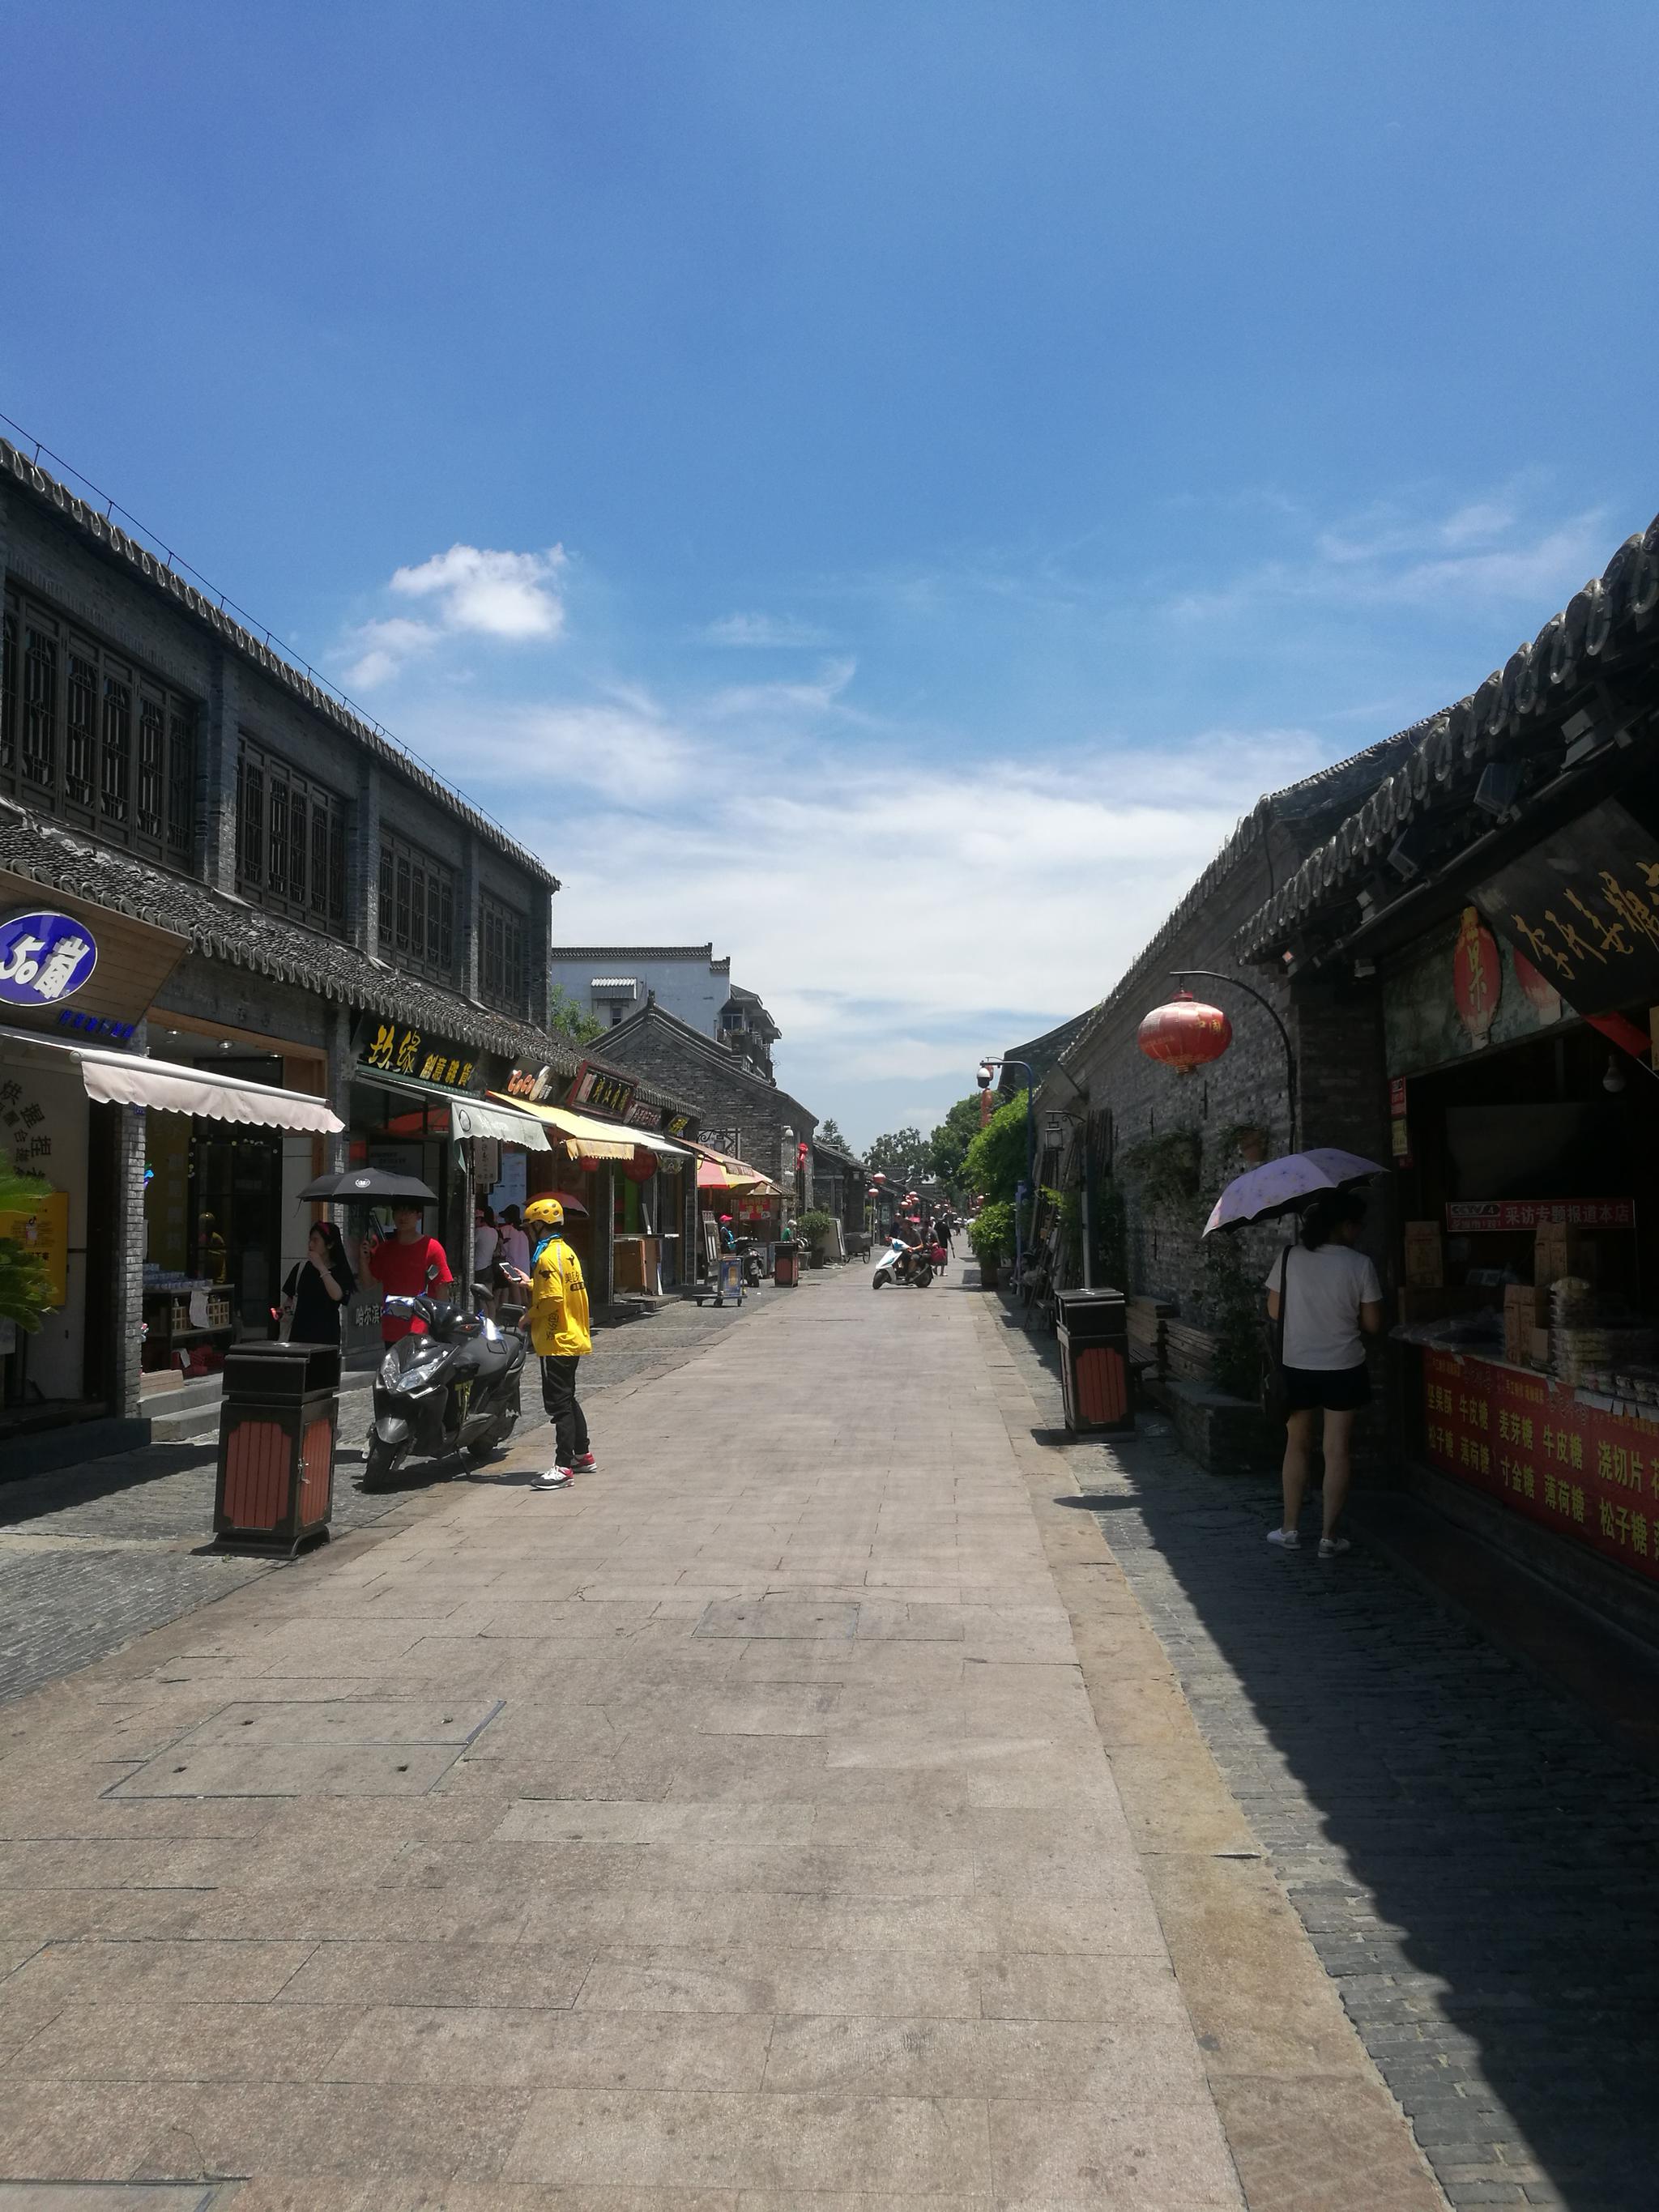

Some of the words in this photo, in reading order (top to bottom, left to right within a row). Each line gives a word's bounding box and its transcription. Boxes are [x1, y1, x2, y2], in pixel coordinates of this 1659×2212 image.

[508, 1069, 535, 1095] CoCo
[1506, 1204, 1630, 1225] 采访专题报道本店
[1459, 1393, 1489, 1431] 牛皮糖
[1460, 1436, 1490, 1475] 薄荷糖
[1499, 1409, 1533, 1451] 麦芽糖
[1543, 1425, 1582, 1470] 牛皮糖
[1501, 1456, 1534, 1498] 寸金糖
[1544, 1473, 1584, 1523] 薄荷糖
[1598, 1440, 1644, 1493] 浇切片
[1599, 1497, 1648, 1557] 松子糖
